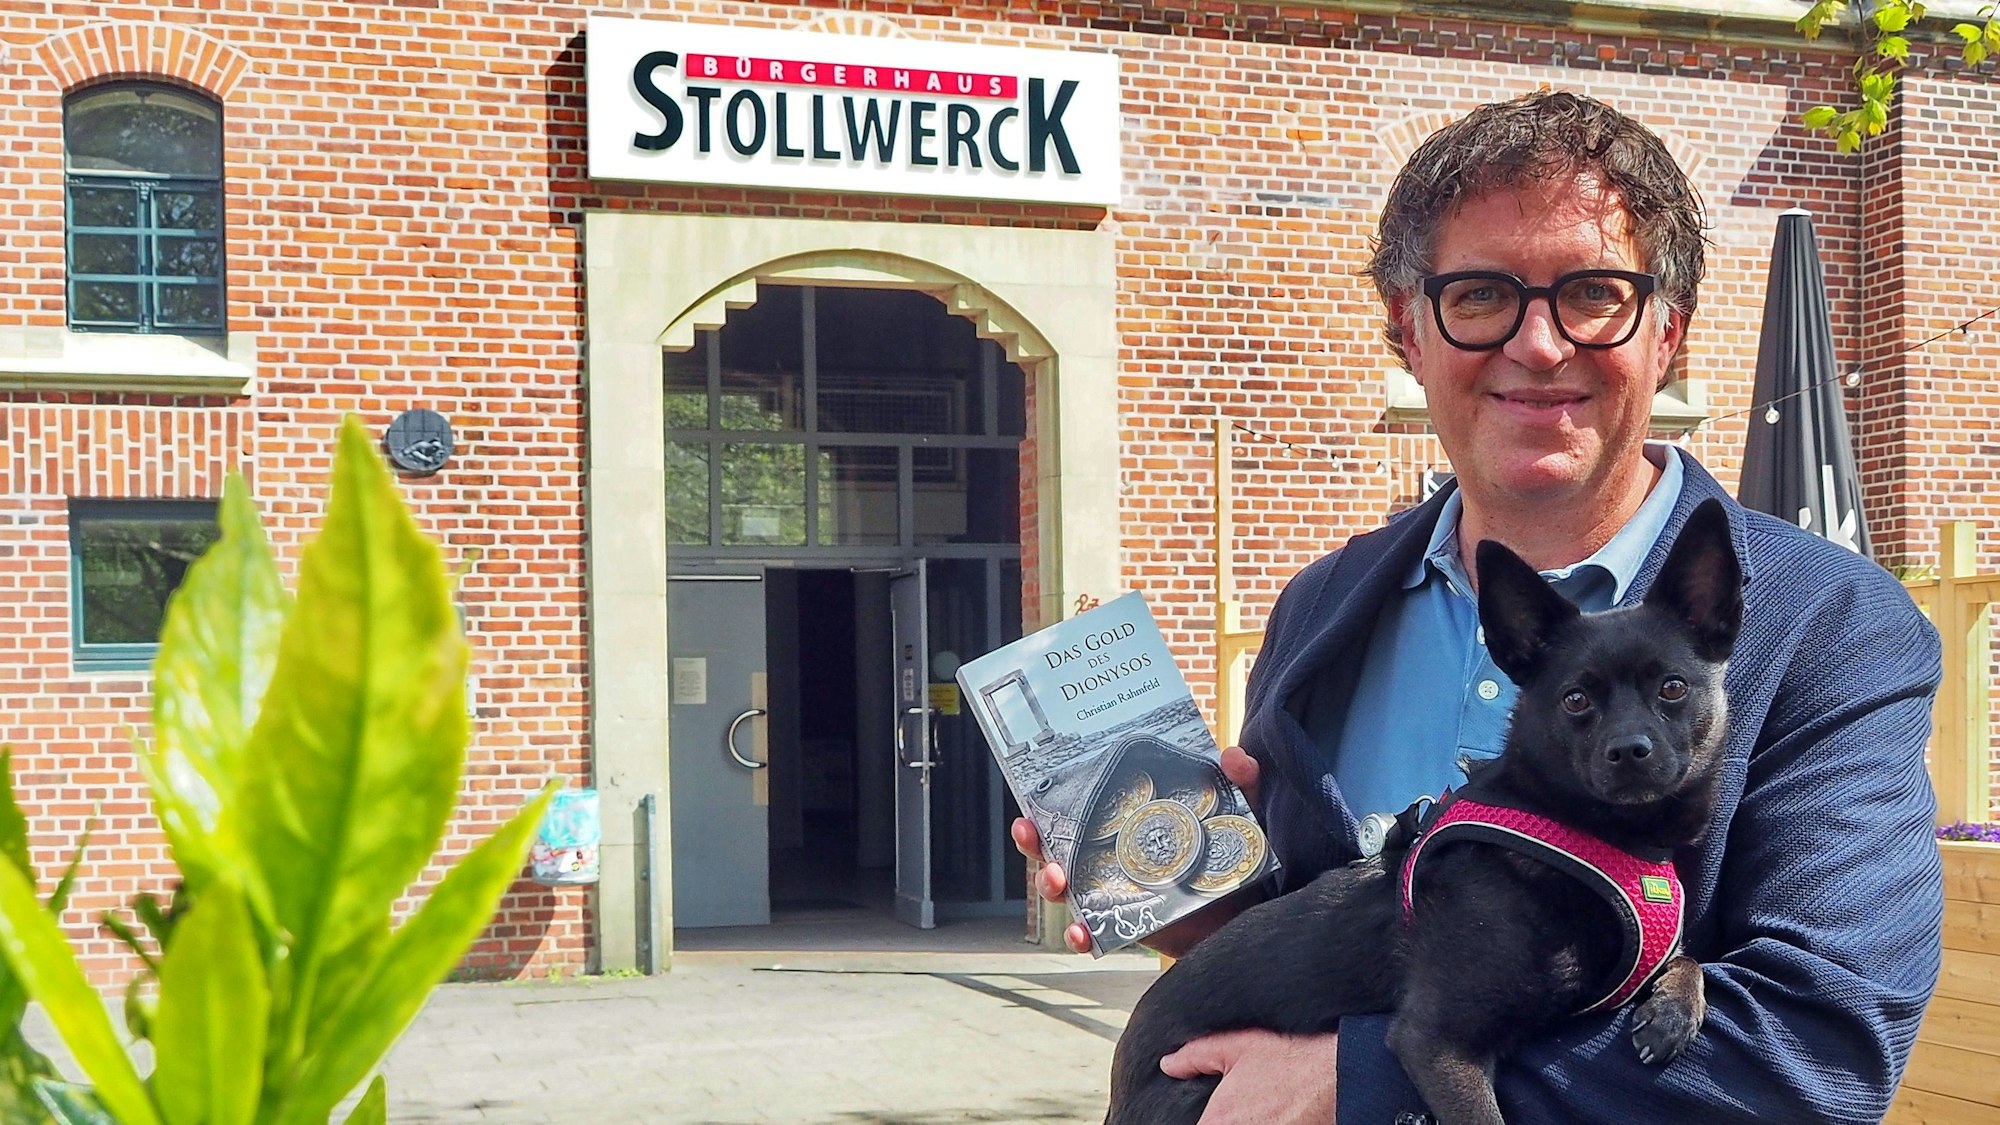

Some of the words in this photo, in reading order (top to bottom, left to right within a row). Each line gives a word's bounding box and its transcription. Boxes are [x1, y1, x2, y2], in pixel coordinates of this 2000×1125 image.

[703, 56, 1003, 96] BÜRGERHAUS
[633, 50, 1081, 175] STOLLWERCK
[1044, 644, 1082, 669] DAS
[1085, 622, 1135, 651] GOLD
[1087, 652, 1111, 669] DES
[1059, 652, 1152, 701] DIONYSOS
[1076, 698, 1118, 721] Christian
[1117, 677, 1161, 703] Rahmfeld
